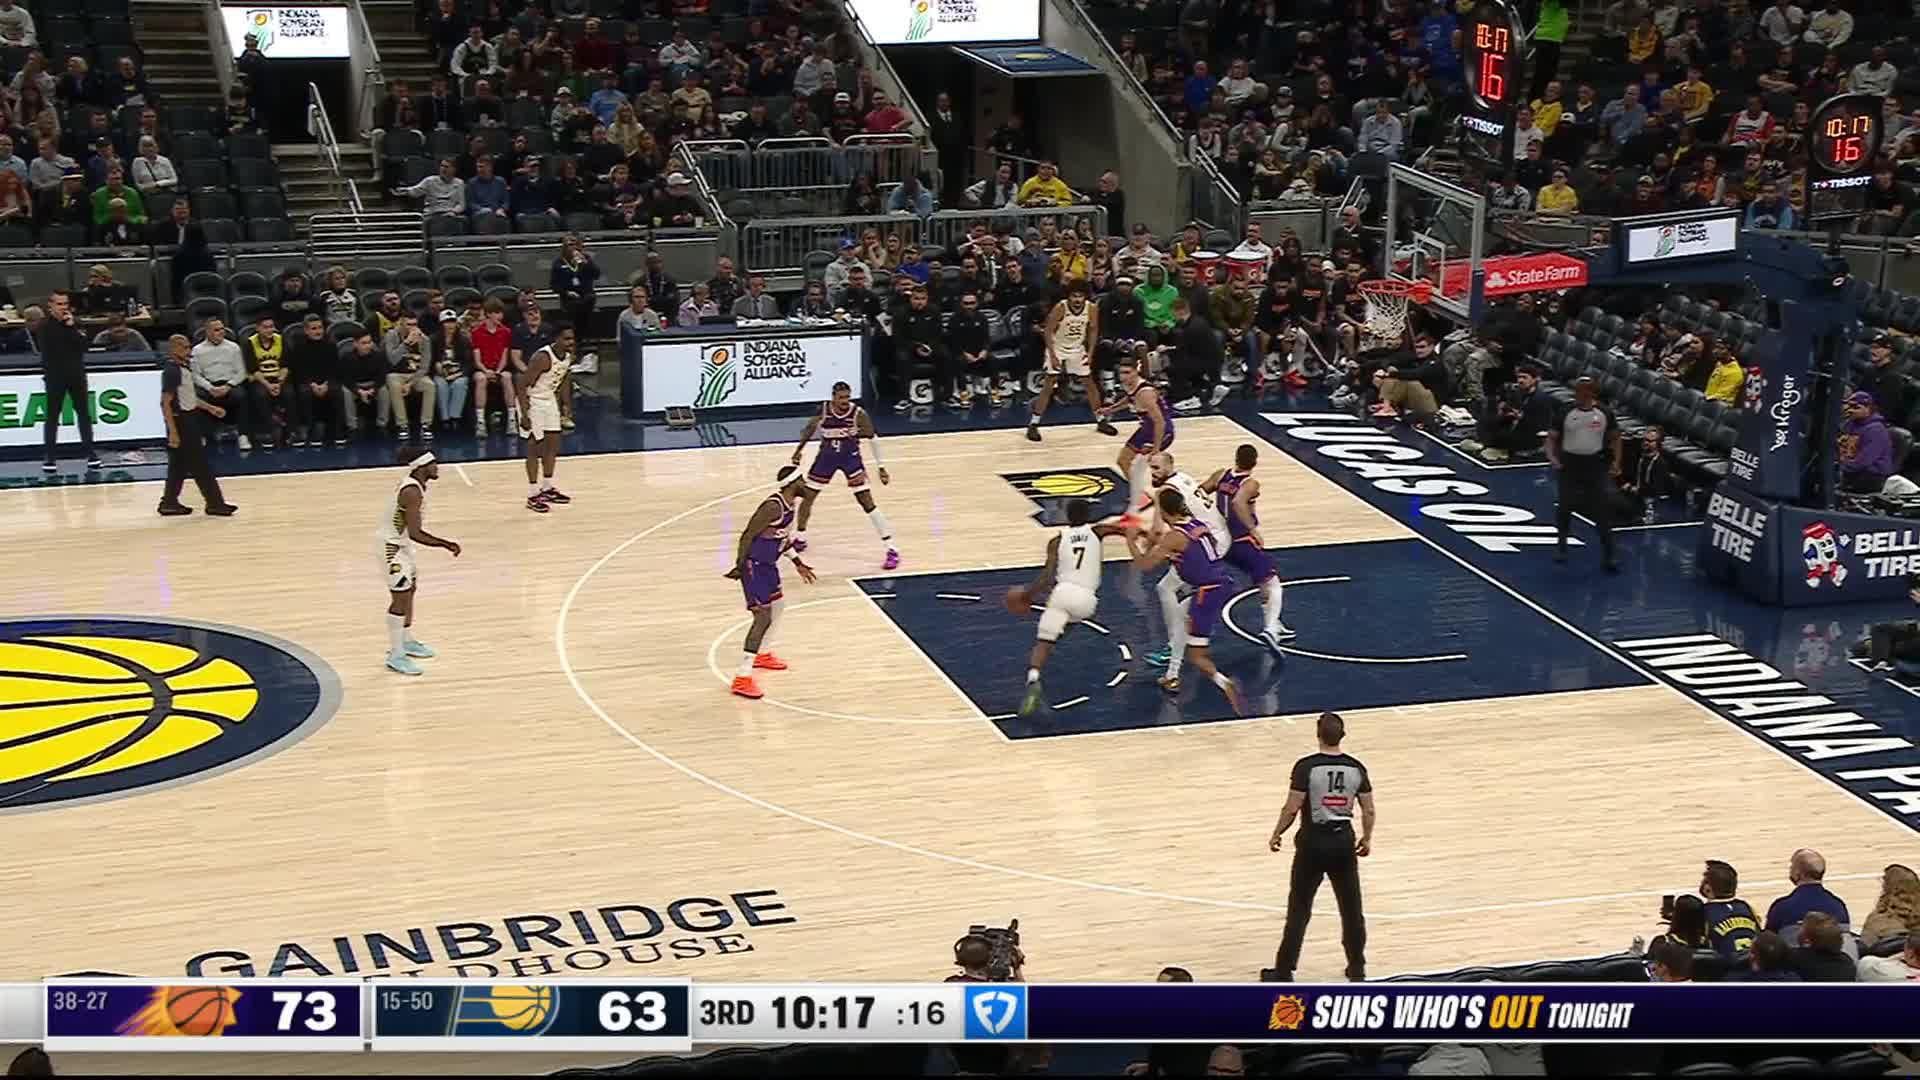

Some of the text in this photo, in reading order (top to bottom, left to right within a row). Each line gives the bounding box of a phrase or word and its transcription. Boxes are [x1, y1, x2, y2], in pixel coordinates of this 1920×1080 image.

[1481, 52, 1504, 100] 16
[1827, 115, 1870, 137] 10:17
[1835, 137, 1861, 162] 16
[744, 340, 802, 354] INDIANA
[744, 352, 806, 367] SOYBEAN
[744, 365, 806, 380] ALLIANCE
[1730, 447, 1760, 468] BELLE
[1258, 412, 1585, 552] LUCAS OIL
[1732, 461, 1754, 480] TIRE
[1707, 492, 1768, 538] BELLE
[1711, 522, 1754, 562] TIRE
[1854, 530, 1920, 555] BELL
[1072, 547, 1085, 569] 7
[1612, 634, 1914, 761] INDIANA
[1327, 771, 1345, 792] 14
[186, 889, 797, 977] GAINBRIDGE
